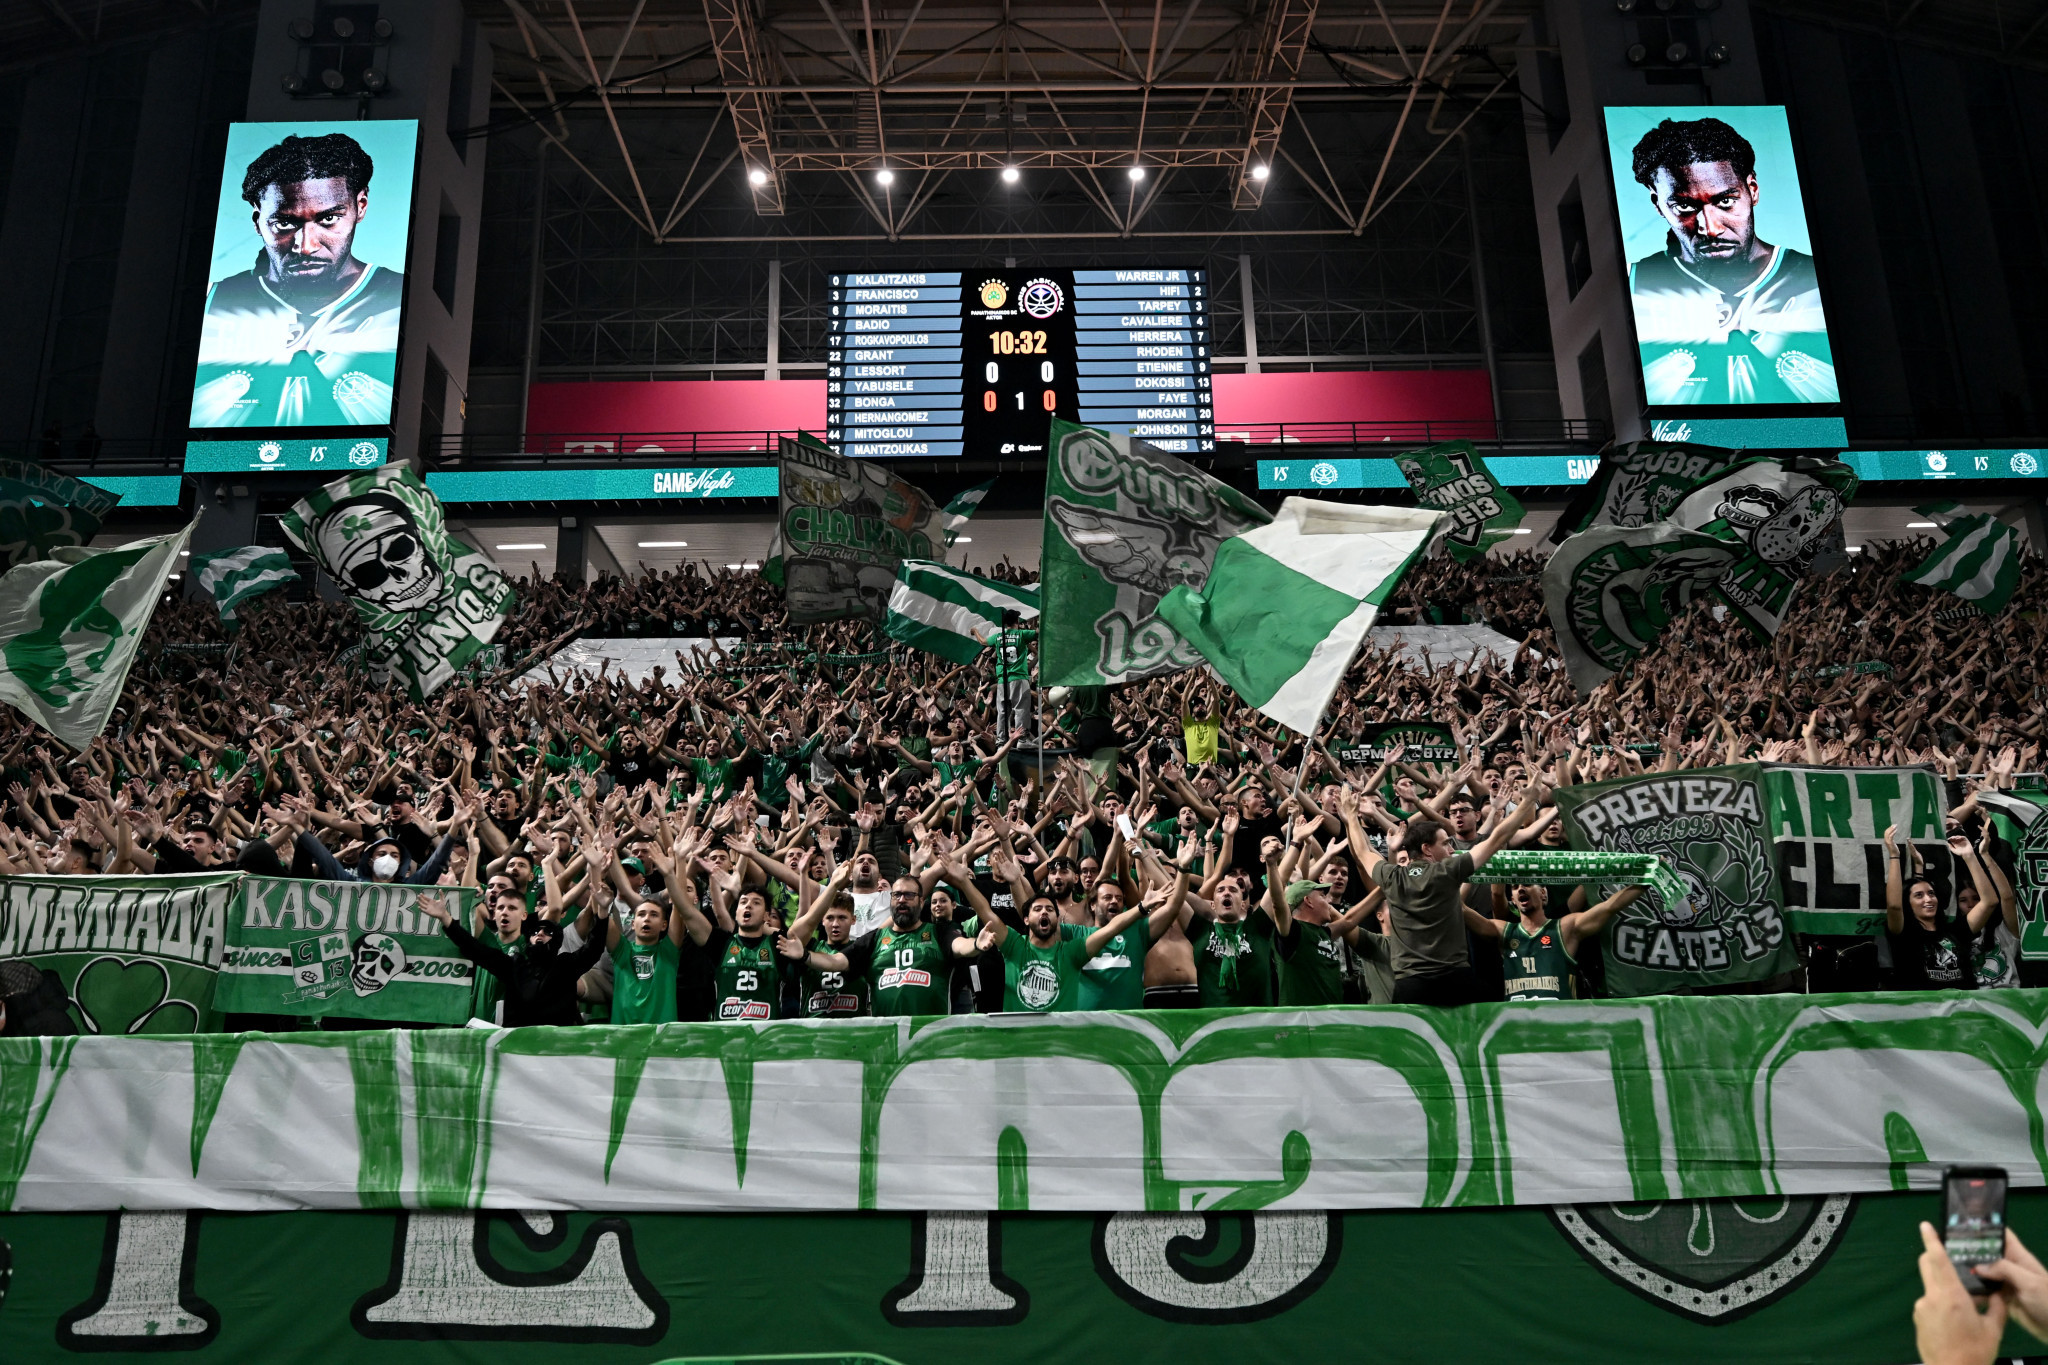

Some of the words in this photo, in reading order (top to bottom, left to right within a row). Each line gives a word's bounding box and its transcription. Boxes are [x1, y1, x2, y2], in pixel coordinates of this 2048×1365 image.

[833, 276, 839, 285] 0
[856, 275, 926, 285] KALAITZAKIS
[1115, 271, 1163, 281] WARREN
[1166, 271, 1179, 281] JR
[1194, 272, 1200, 281] 1
[833, 291, 839, 300] 3
[856, 289, 918, 300] FRANCISCO
[1160, 286, 1180, 296] HIFI
[1194, 287, 1201, 296] 2
[832, 306, 839, 315] 6
[856, 304, 907, 315] MORAITIS
[1138, 301, 1181, 311] TARPEY
[1196, 302, 1202, 311] 3
[832, 321, 839, 330] 7
[856, 320, 889, 330] BADIO
[1121, 316, 1183, 326] CAVALIERE
[1197, 317, 1203, 326] 4
[830, 336, 841, 345] 17
[855, 334, 929, 345] ROGKAVOPOULOS
[1129, 331, 1183, 341] HERRERA
[1197, 332, 1204, 341] 7
[989, 330, 1047, 354] 10:32
[829, 351, 841, 361] 22
[855, 350, 893, 361] GRANT
[1137, 347, 1183, 357] RHODEN
[1198, 347, 1205, 357] 8
[829, 367, 840, 377] 26
[855, 366, 906, 376] LESSORT
[986, 362, 999, 383] 0
[1041, 361, 1054, 383] 0
[1137, 362, 1184, 373] ETIENNE
[1199, 362, 1206, 372] 9
[829, 382, 840, 392] 28
[855, 381, 914, 391] YABUSELE
[1135, 378, 1185, 388] DOKOSSI
[1198, 378, 1210, 388] 13
[829, 398, 840, 408] 32
[855, 397, 895, 407] BONGA
[984, 390, 997, 412] 0
[1015, 391, 1024, 410] 1
[1043, 389, 1056, 411] 0
[1158, 393, 1187, 403] FAYE
[1199, 394, 1210, 403] 15
[828, 414, 840, 423] 41
[854, 412, 928, 423] HERNANGOMEZ
[1137, 409, 1187, 419] MORGAN
[1200, 409, 1211, 419] 20
[828, 430, 840, 439] 44
[854, 428, 913, 439] MITOGLOU
[1134, 425, 1188, 435] JOHNSON
[1200, 425, 1212, 435] 24
[854, 444, 928, 455] MANTZOUKAS
[1202, 441, 1214, 450] 34
[310, 447, 327, 462] VS
[1566, 458, 1600, 480] GAM
[1974, 457, 1989, 470] VS
[1274, 467, 1289, 482] VS
[653, 473, 694, 493] GAME
[688, 468, 736, 498] Night
[483, 583, 511, 621] CLUB
[386, 564, 502, 692] TINOS
[822, 654, 887, 664] ANATHINAIKOS
[1342, 747, 1385, 760] ΘΕΡΜ
[1765, 770, 1947, 839] ARTA
[1577, 779, 1760, 842] PREVEZA
[1632, 813, 1716, 844] est.1995
[1479, 856, 1651, 877] ANATHINAIKOS
[0, 882, 230, 969] ΜΑΛΙΑΔΑ
[1616, 924, 1728, 968] GATE
[1736, 905, 1784, 957] 13
[298, 943, 313, 962] G
[894, 948, 914, 968] 10
[228, 945, 284, 967] since
[408, 960, 468, 979] 2009
[1521, 956, 1537, 974] 41
[328, 960, 345, 980] 13
[737, 970, 758, 991] 25
[821, 971, 844, 989] 25
